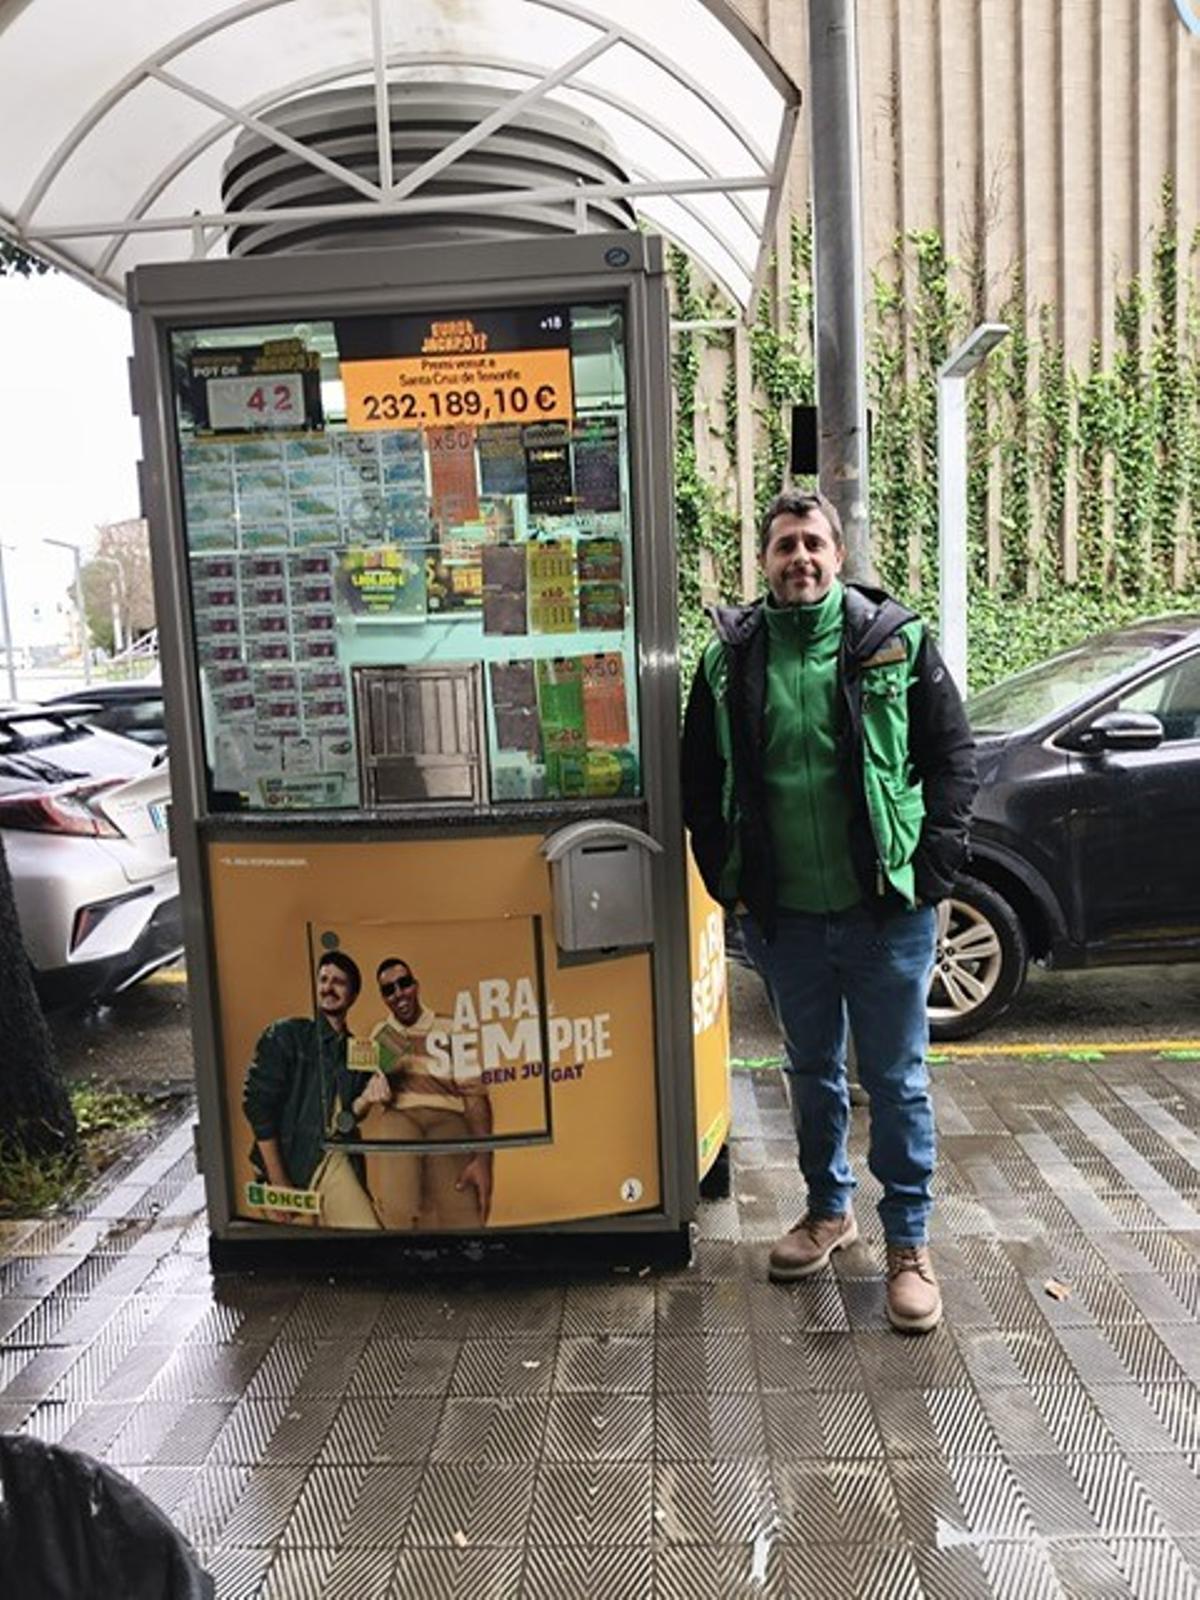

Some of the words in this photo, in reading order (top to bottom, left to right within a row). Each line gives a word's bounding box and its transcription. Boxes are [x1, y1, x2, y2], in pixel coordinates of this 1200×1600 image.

[399, 373, 431, 387] Santa
[432, 372, 459, 386] Cruz
[462, 370, 475, 383] de
[477, 368, 521, 381] Tenerife
[363, 385, 529, 421] 232.189,10
[534, 384, 557, 413] €
[425, 1013, 613, 1081] SEMPRE
[481, 1066, 516, 1085] BEN
[266, 1190, 318, 1210] ONCE
